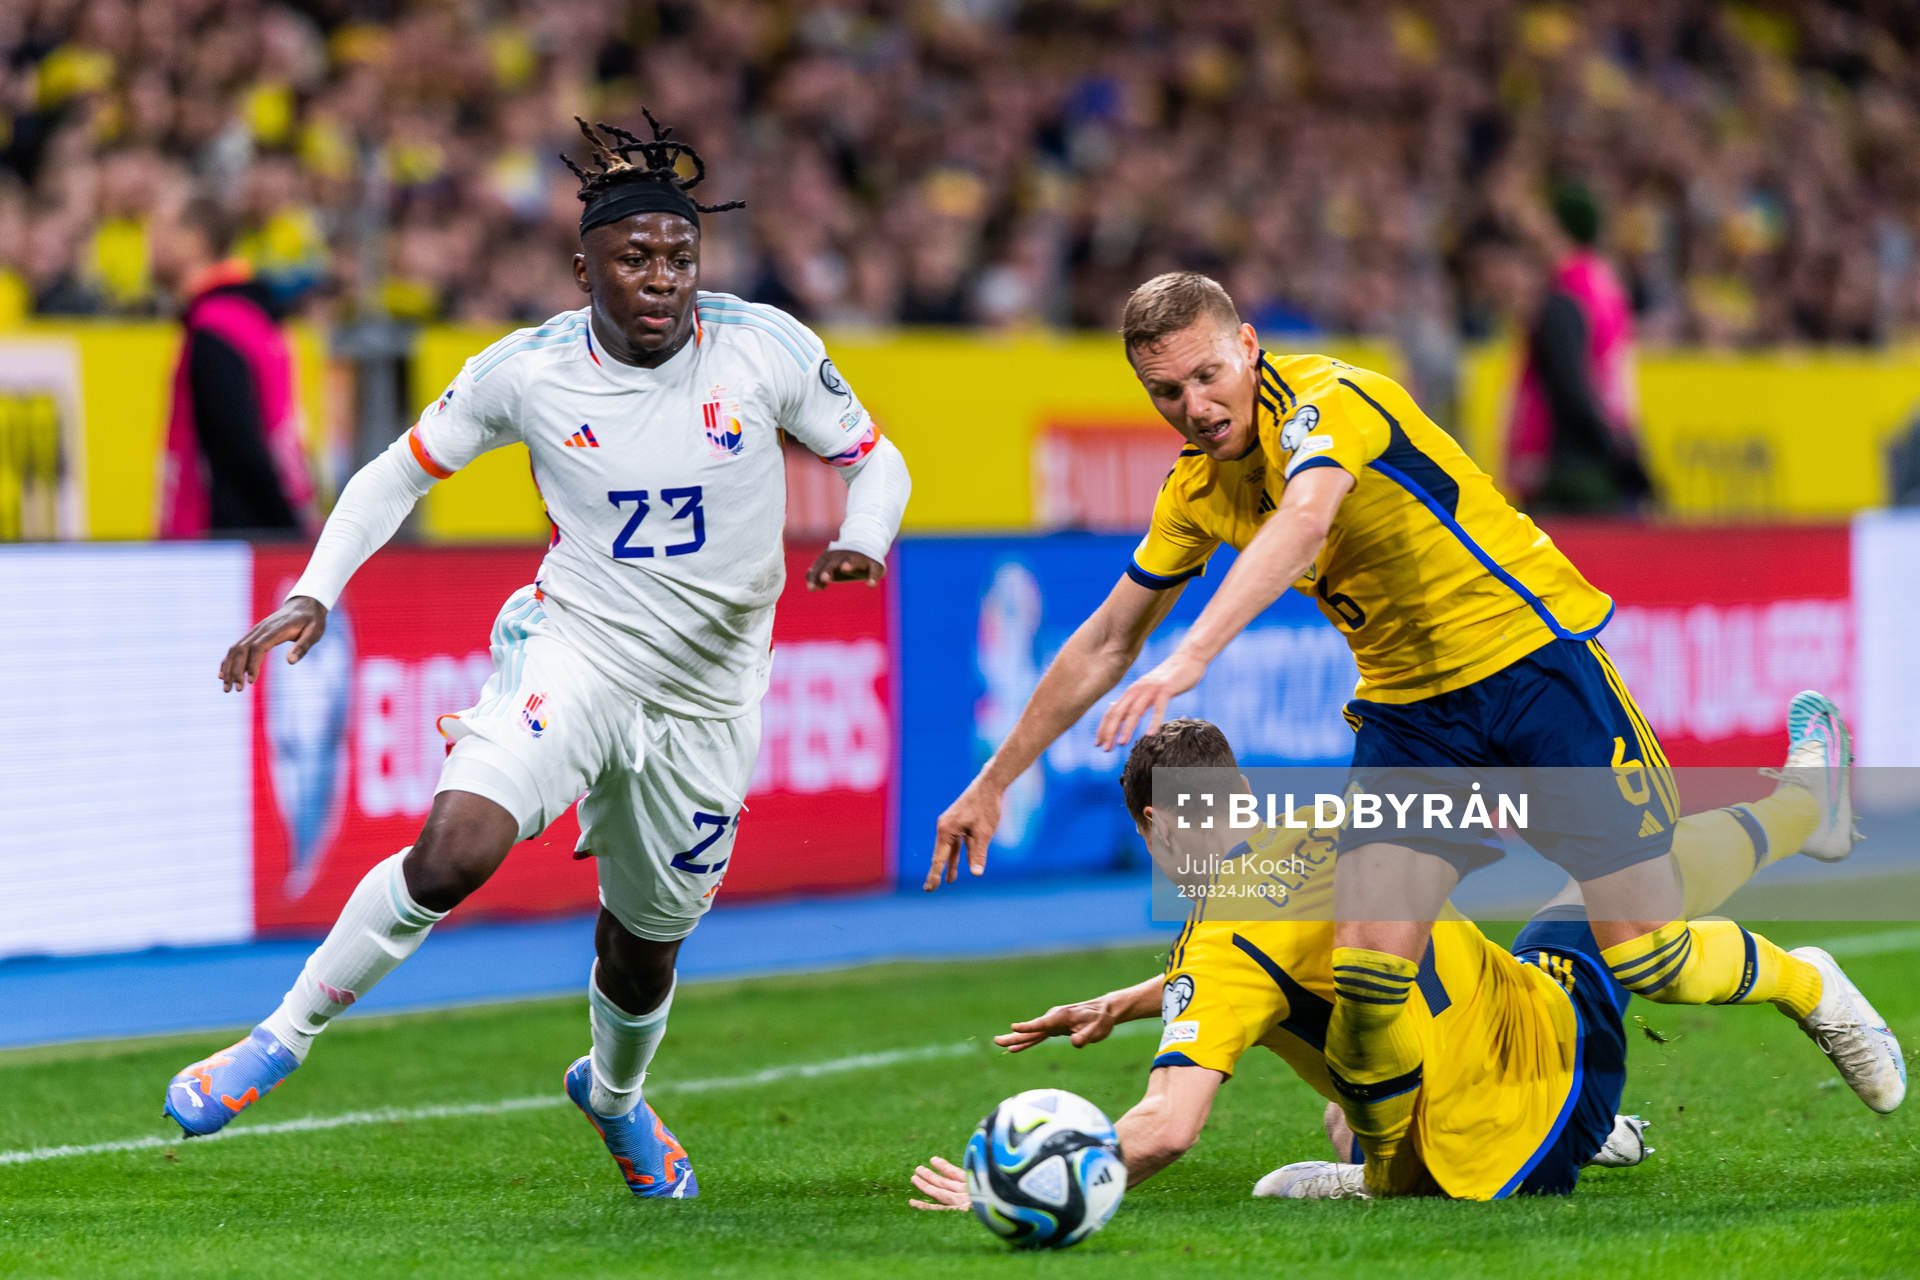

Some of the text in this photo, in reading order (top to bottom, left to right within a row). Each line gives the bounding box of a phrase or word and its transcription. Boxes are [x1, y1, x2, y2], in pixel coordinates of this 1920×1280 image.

[607, 485, 706, 559] 23
[1318, 575, 1366, 630] 6
[1611, 736, 1651, 806] 6
[1260, 826, 1339, 908] CLAES
